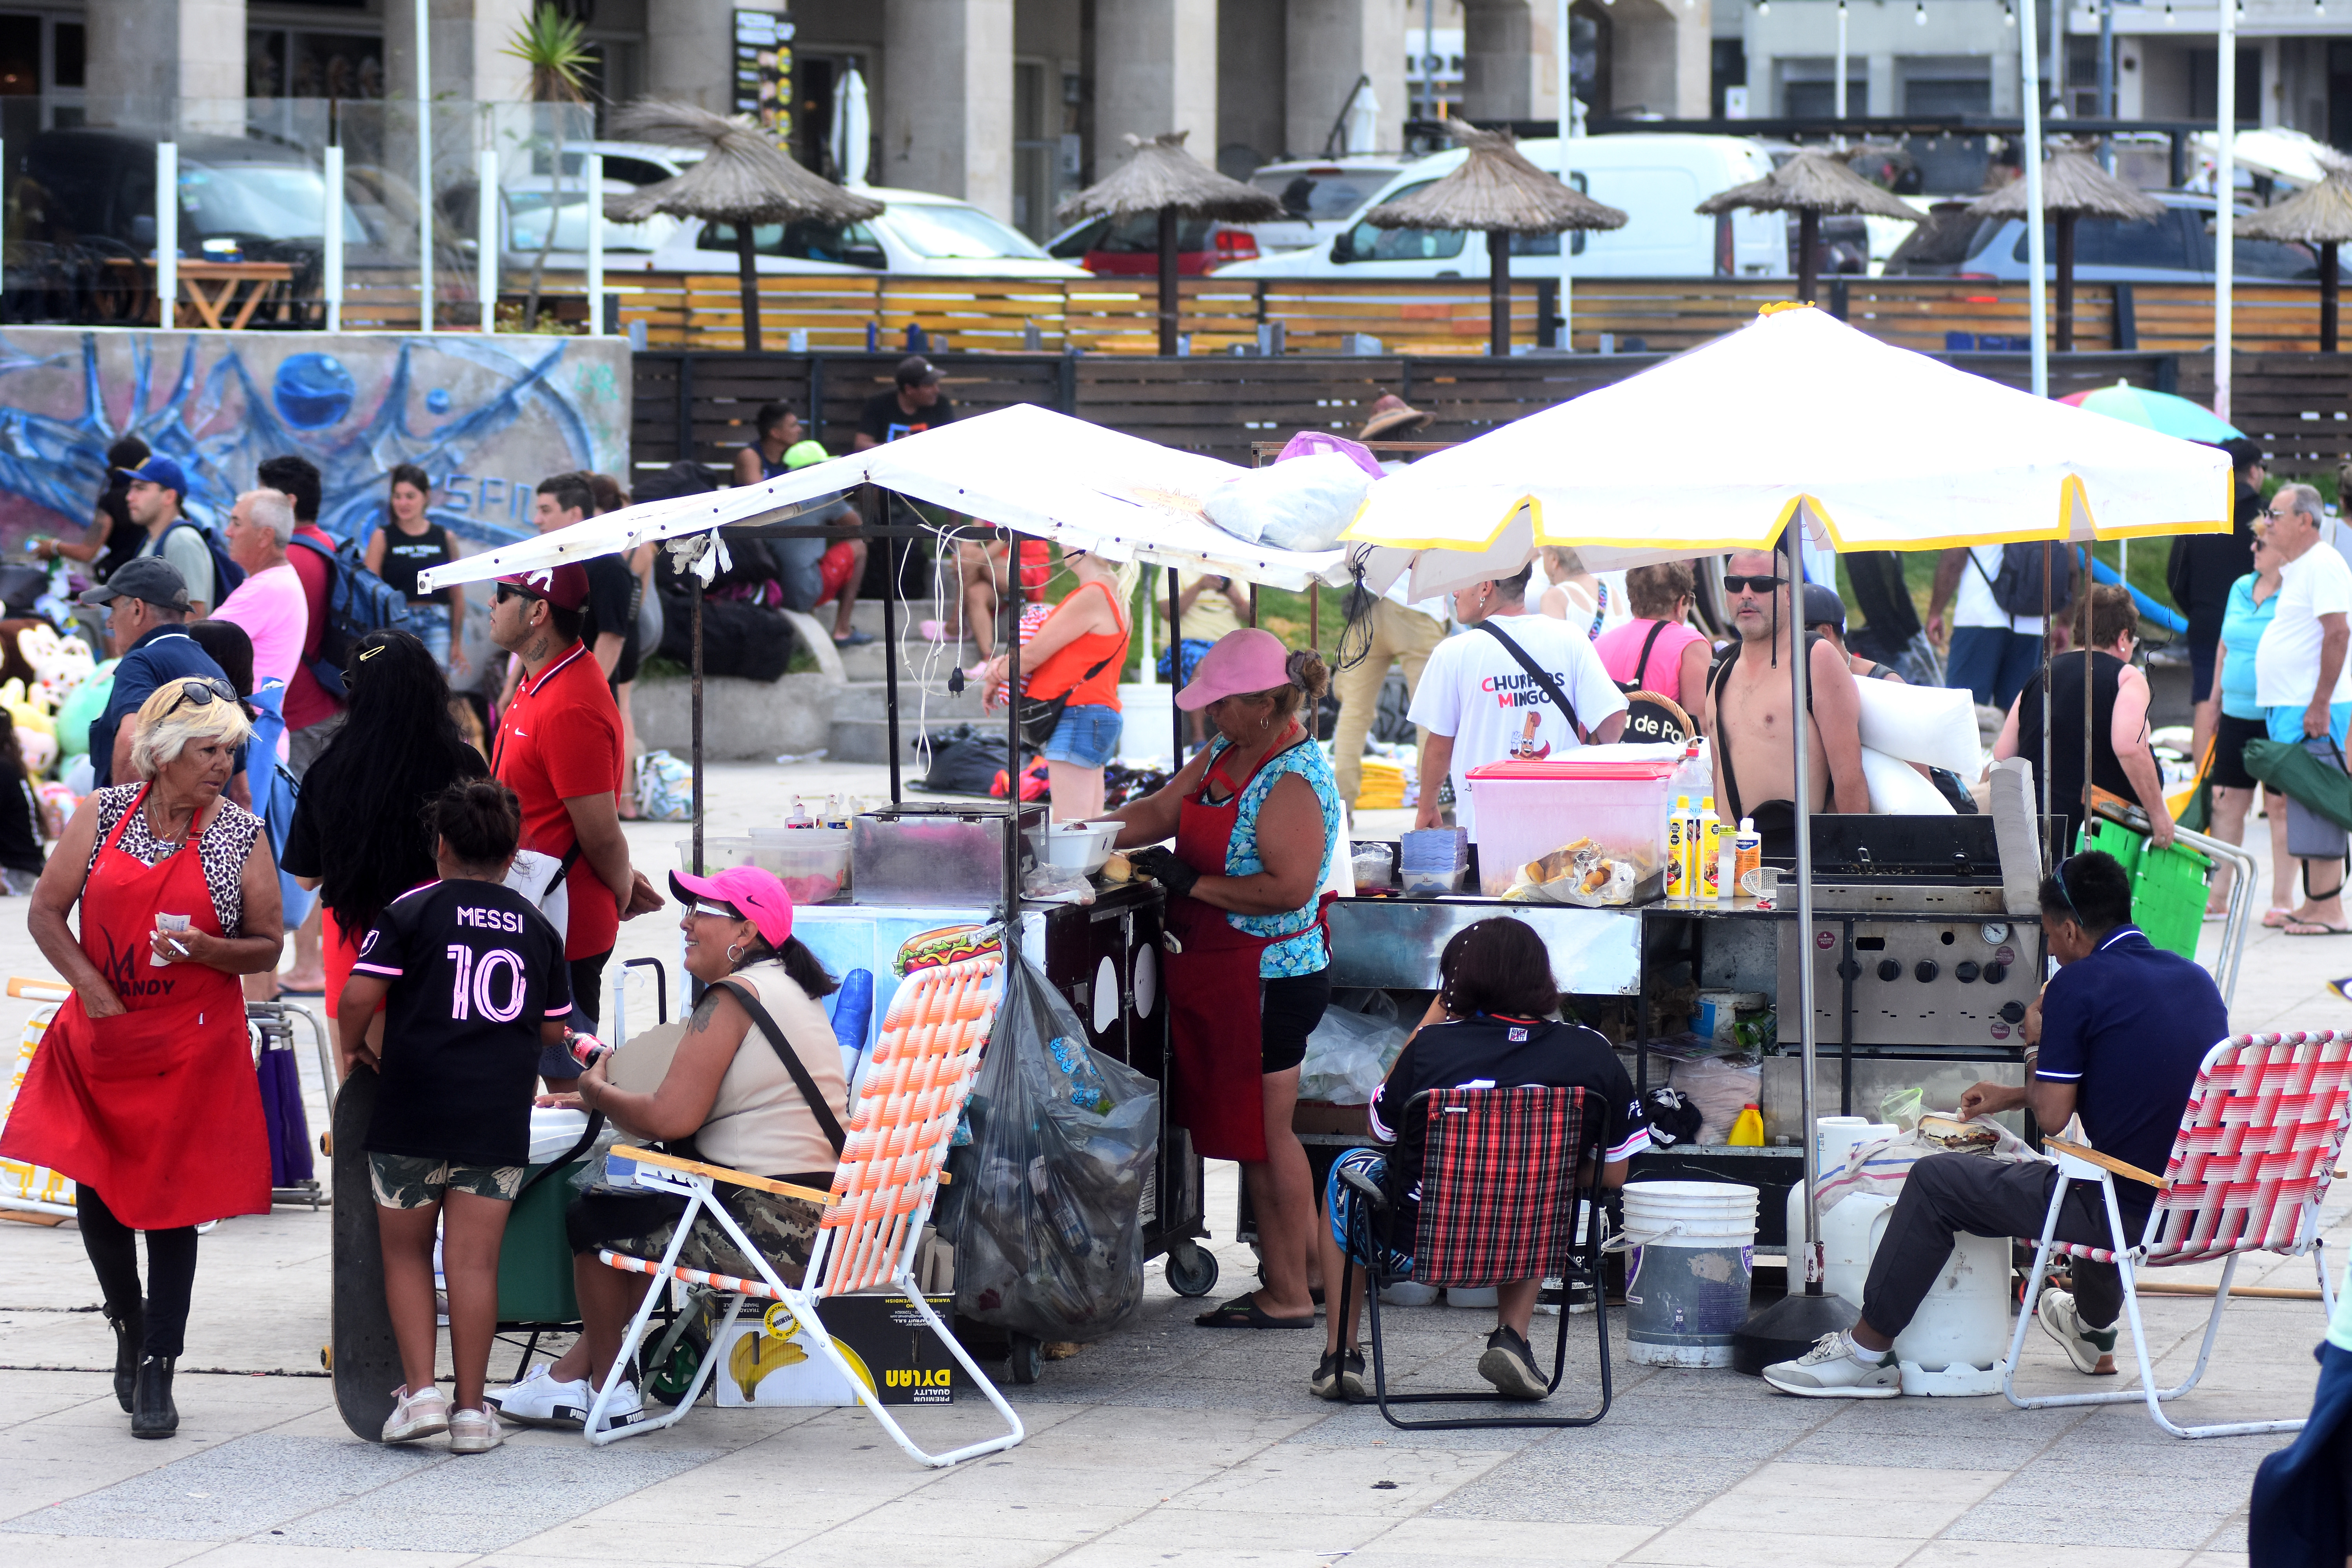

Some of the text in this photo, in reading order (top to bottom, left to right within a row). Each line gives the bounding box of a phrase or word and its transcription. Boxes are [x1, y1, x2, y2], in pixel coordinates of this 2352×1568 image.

[1498, 690, 1552, 708] MINGO
[1635, 715, 1659, 735] de
[457, 906, 523, 933] MESSI
[447, 944, 527, 1023] 10
[772, 1313, 794, 1328] PREMIUM
